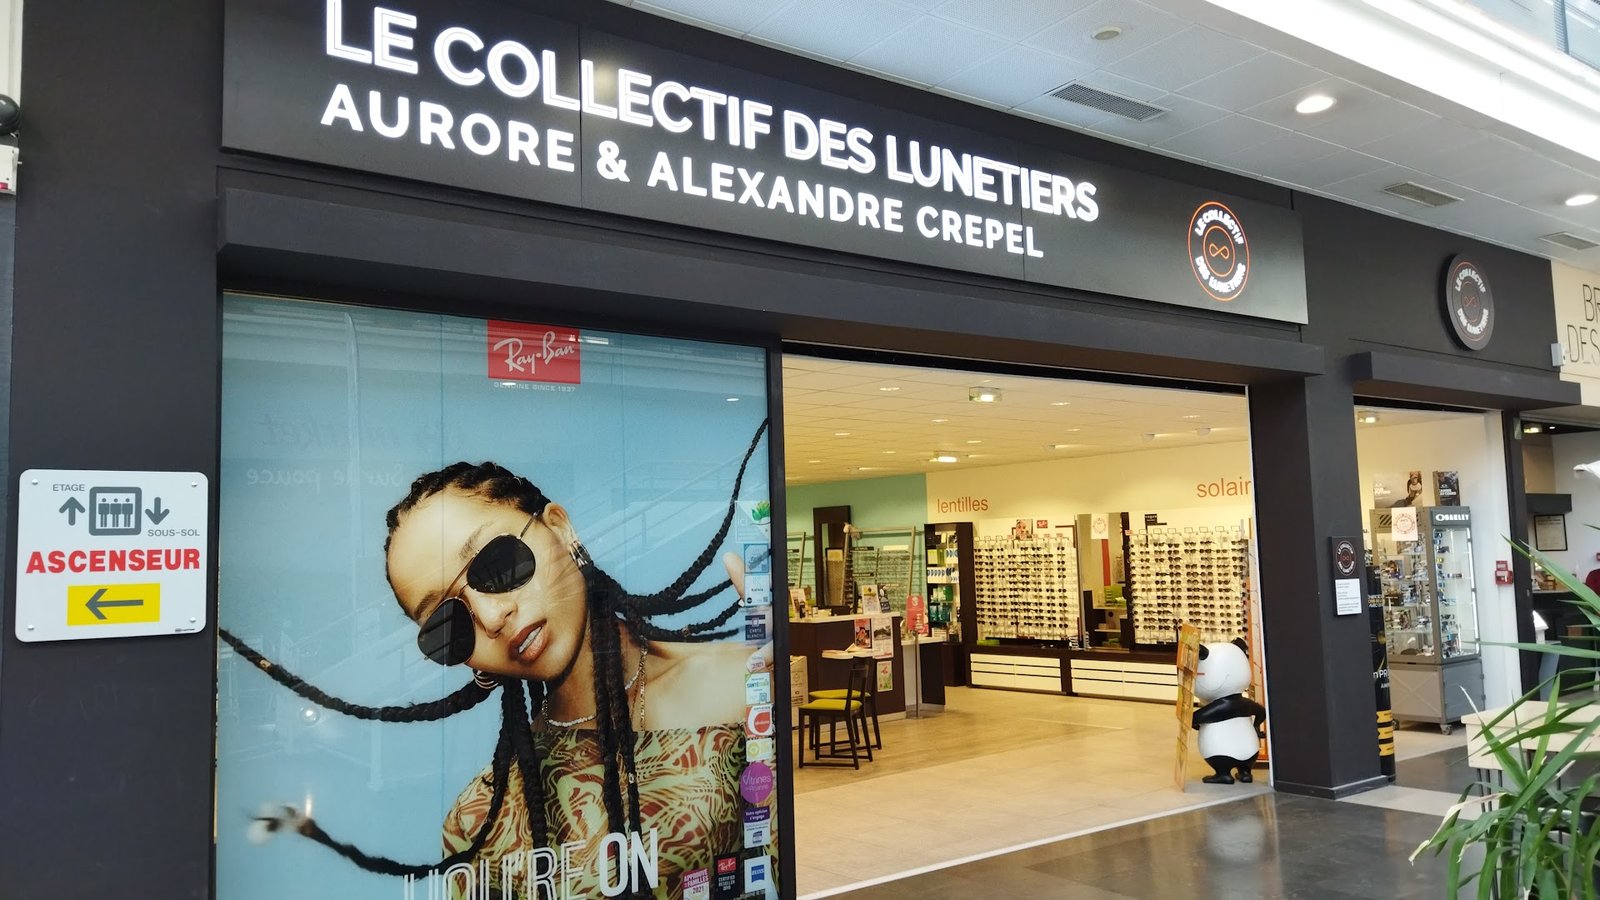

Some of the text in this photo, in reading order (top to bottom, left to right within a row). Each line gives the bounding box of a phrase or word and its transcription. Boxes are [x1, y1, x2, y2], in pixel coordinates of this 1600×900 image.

[326, 0, 1100, 221] LE COLLECTIF DES LUNETIERS
[320, 83, 1044, 258] AURORE & ALEXANDRE CREPEL
[52, 484, 85, 492] ETAGE
[937, 496, 989, 513] lentilles
[147, 529, 200, 537] SOUS-SOL
[25, 548, 200, 574] ASCENSEUR
[742, 769, 771, 785] Vitrines
[599, 828, 659, 897] ON
